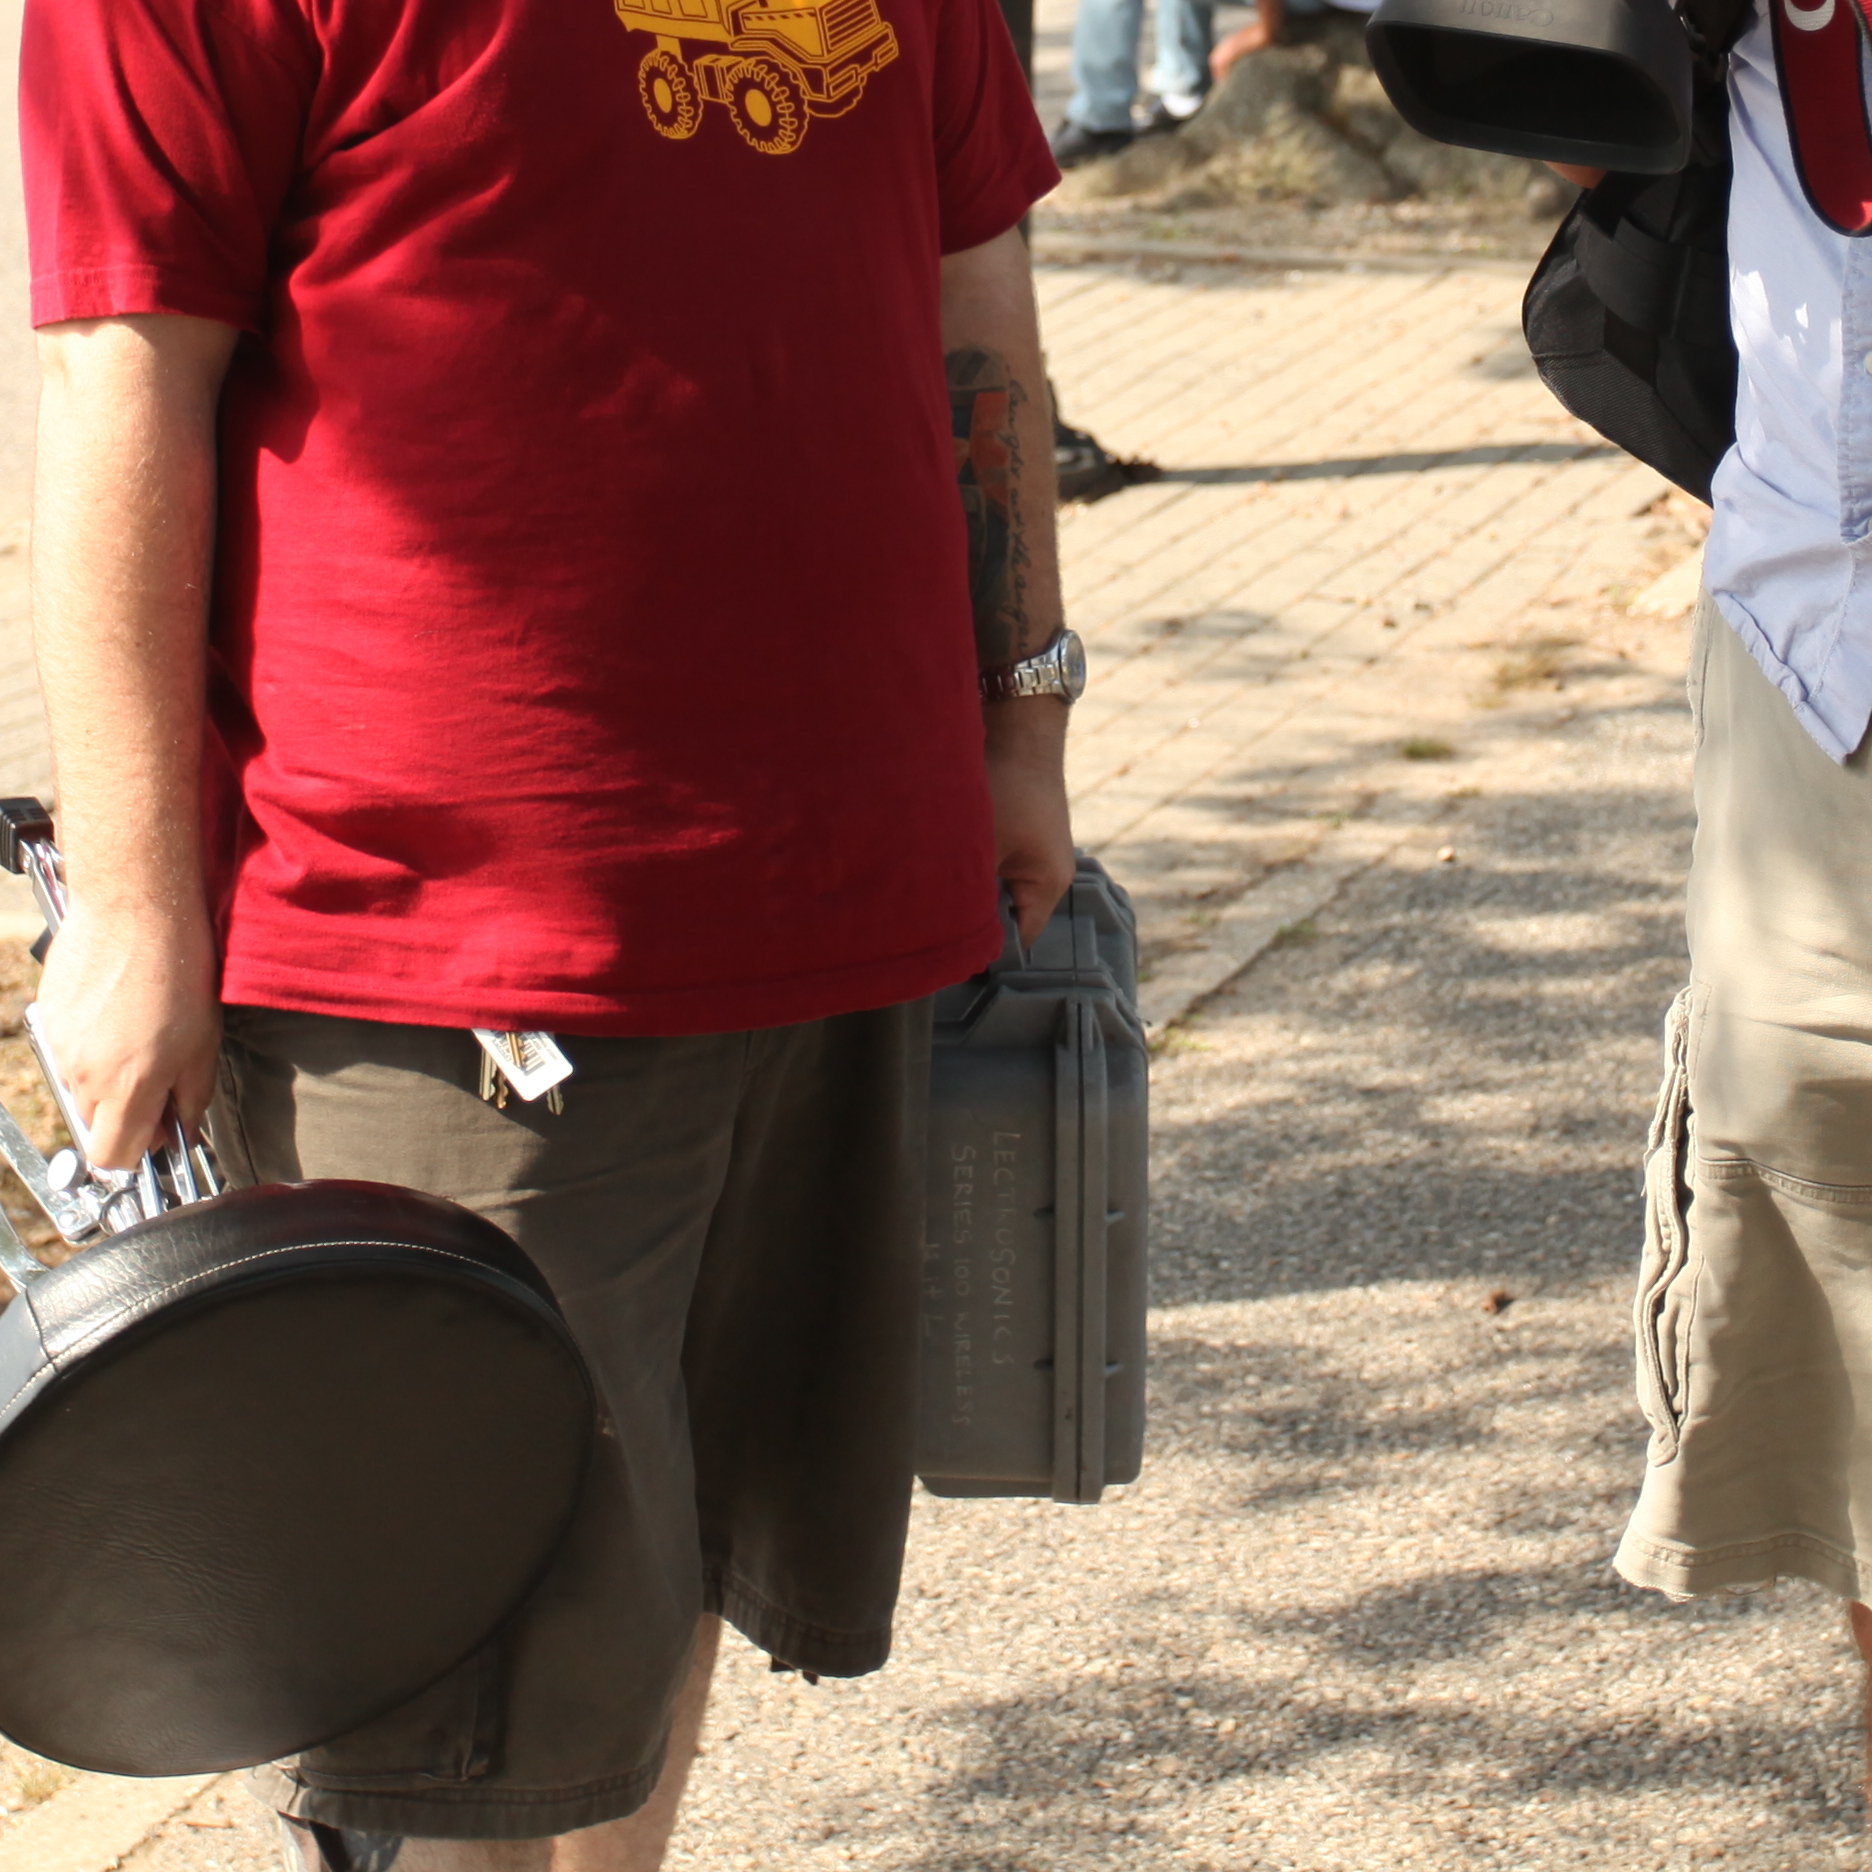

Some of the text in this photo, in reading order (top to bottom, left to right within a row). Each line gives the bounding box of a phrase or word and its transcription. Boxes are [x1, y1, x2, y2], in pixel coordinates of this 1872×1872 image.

[1460, 0, 1554, 28] Canon
[951, 1145, 976, 1426] SERIES 100 WIRELESS
[991, 1131, 1022, 1365] LECTROSONICS
